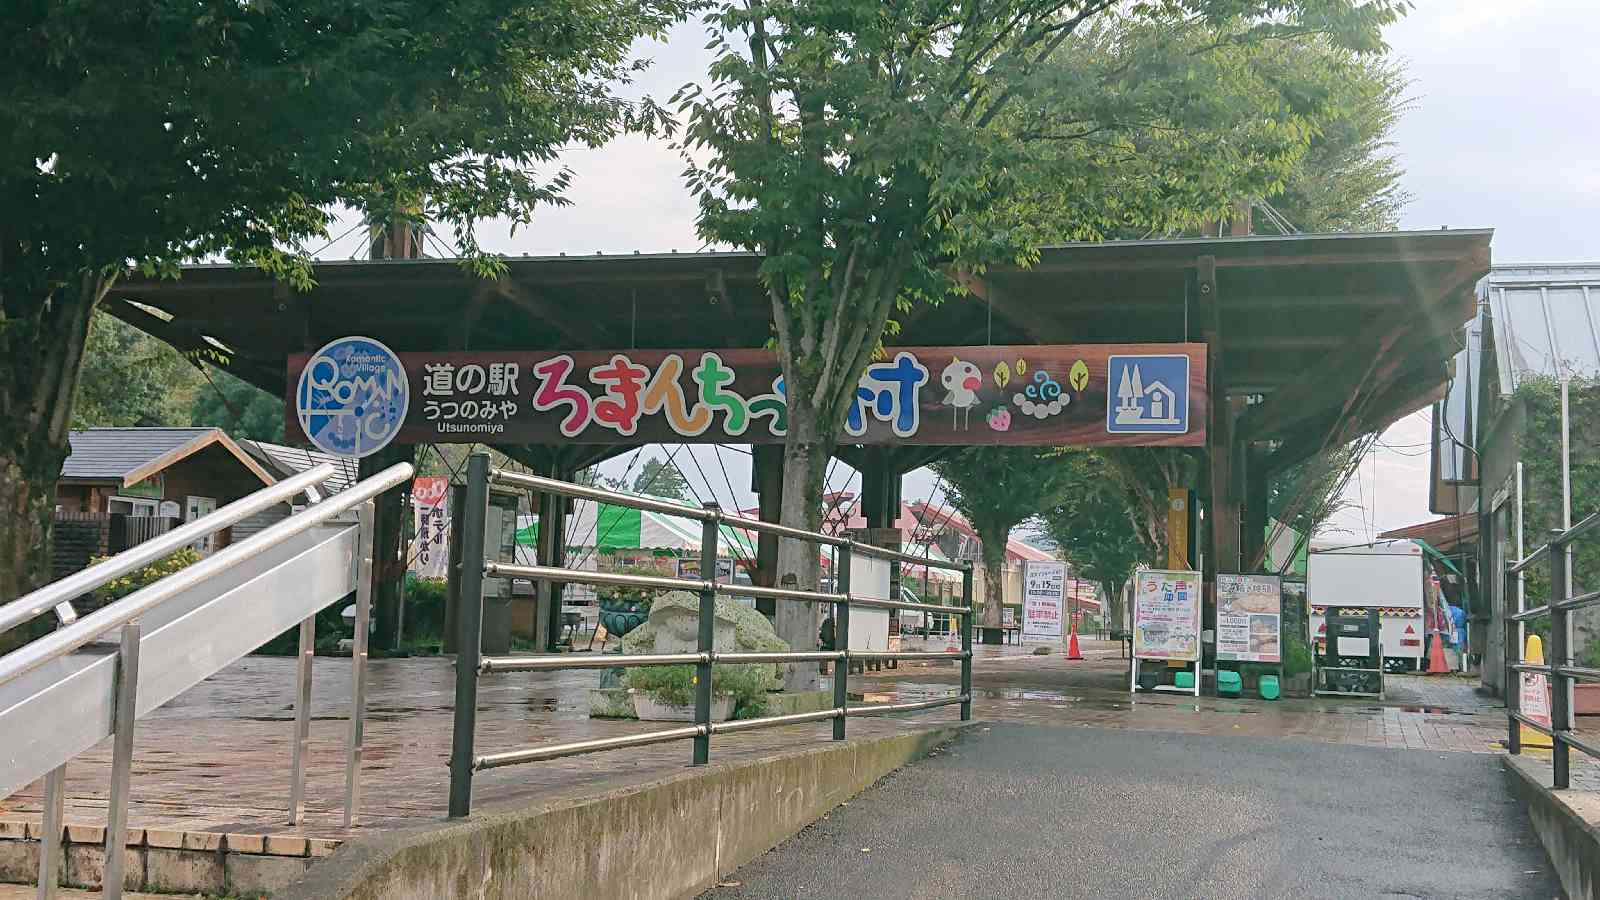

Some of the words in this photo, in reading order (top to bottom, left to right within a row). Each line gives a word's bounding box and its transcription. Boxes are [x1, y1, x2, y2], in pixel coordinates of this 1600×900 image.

[422, 363, 520, 396] 道の駅
[423, 400, 518, 420] うつのみや
[437, 422, 504, 434] Utsunomiya
